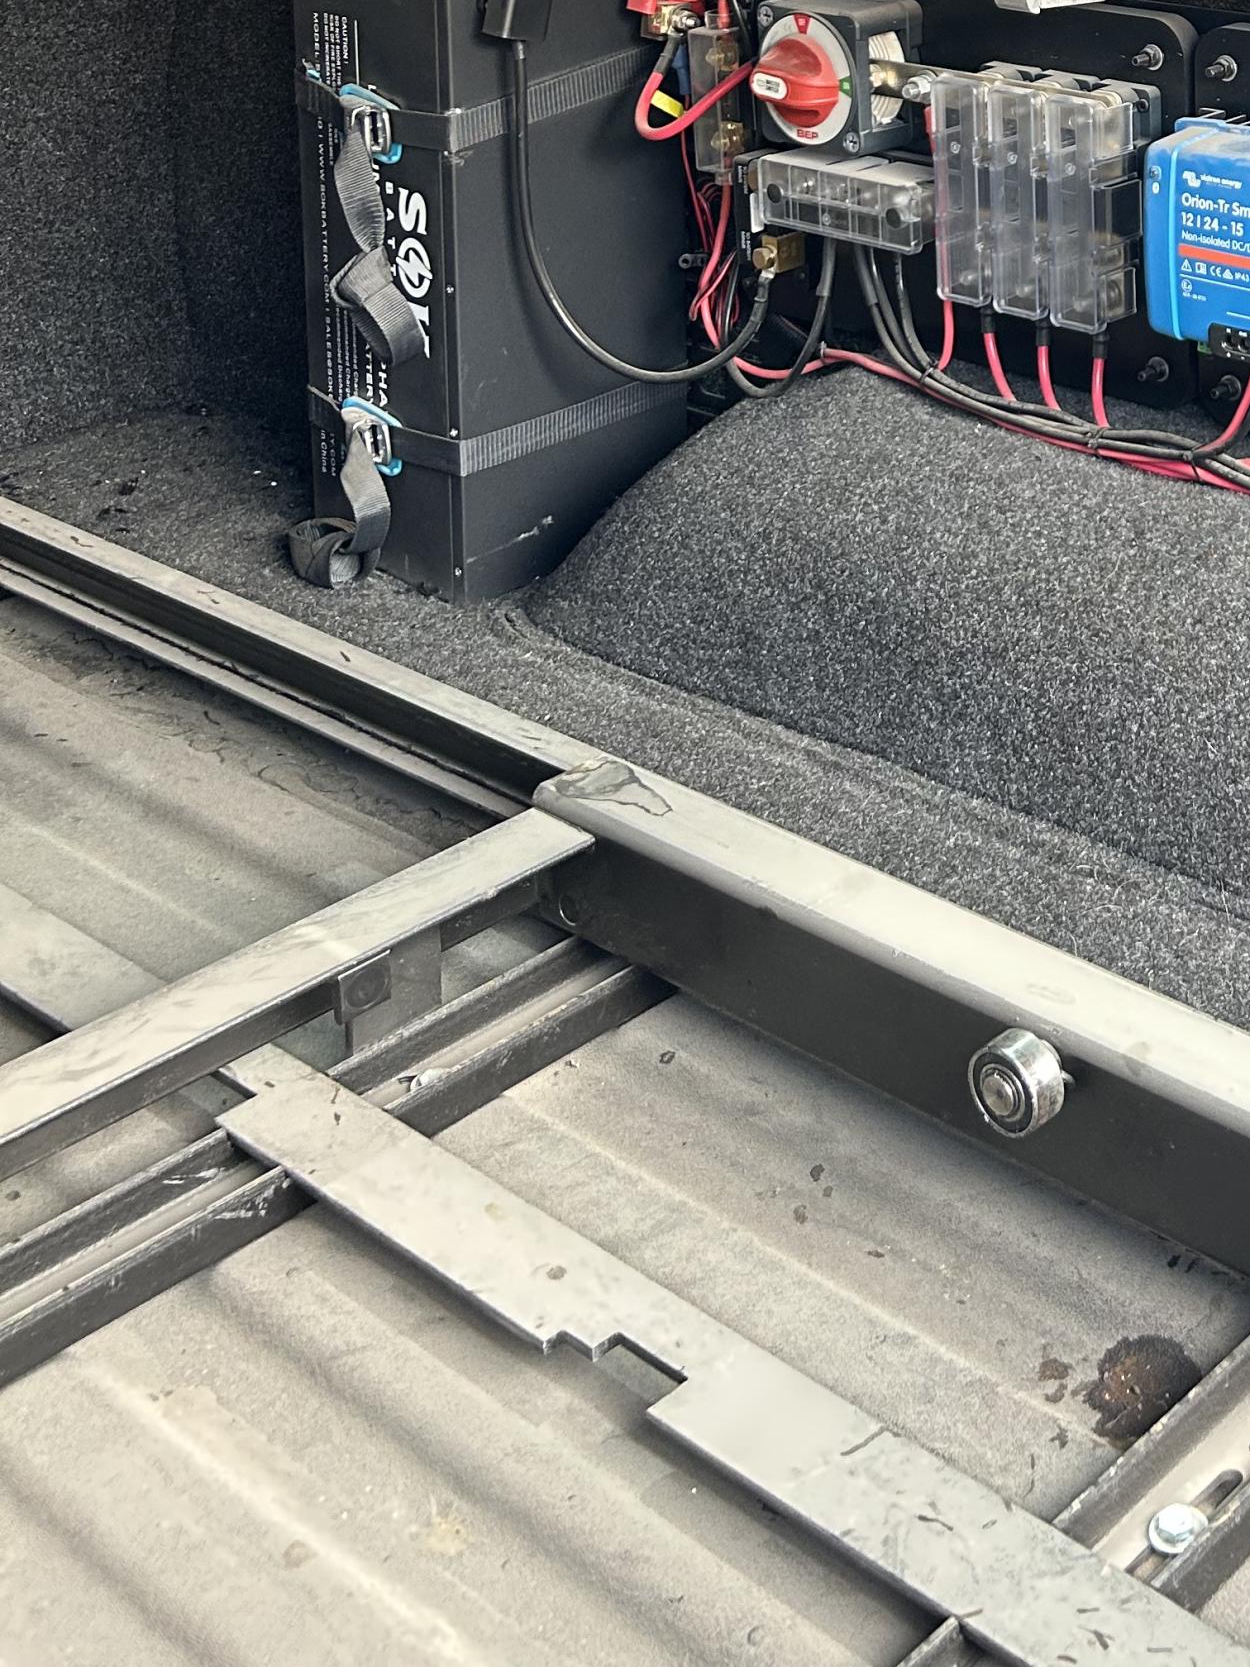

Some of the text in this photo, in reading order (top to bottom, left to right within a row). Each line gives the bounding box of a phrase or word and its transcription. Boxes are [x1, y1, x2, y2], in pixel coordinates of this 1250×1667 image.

[341, 16, 349, 60] CAUTION
[1181, 192, 1230, 214] Orion-Tr
[1181, 212, 1194, 227] 12
[1203, 215, 1219, 232] 24
[1231, 221, 1244, 237] 15
[1181, 230, 1231, 249] Non-isolated
